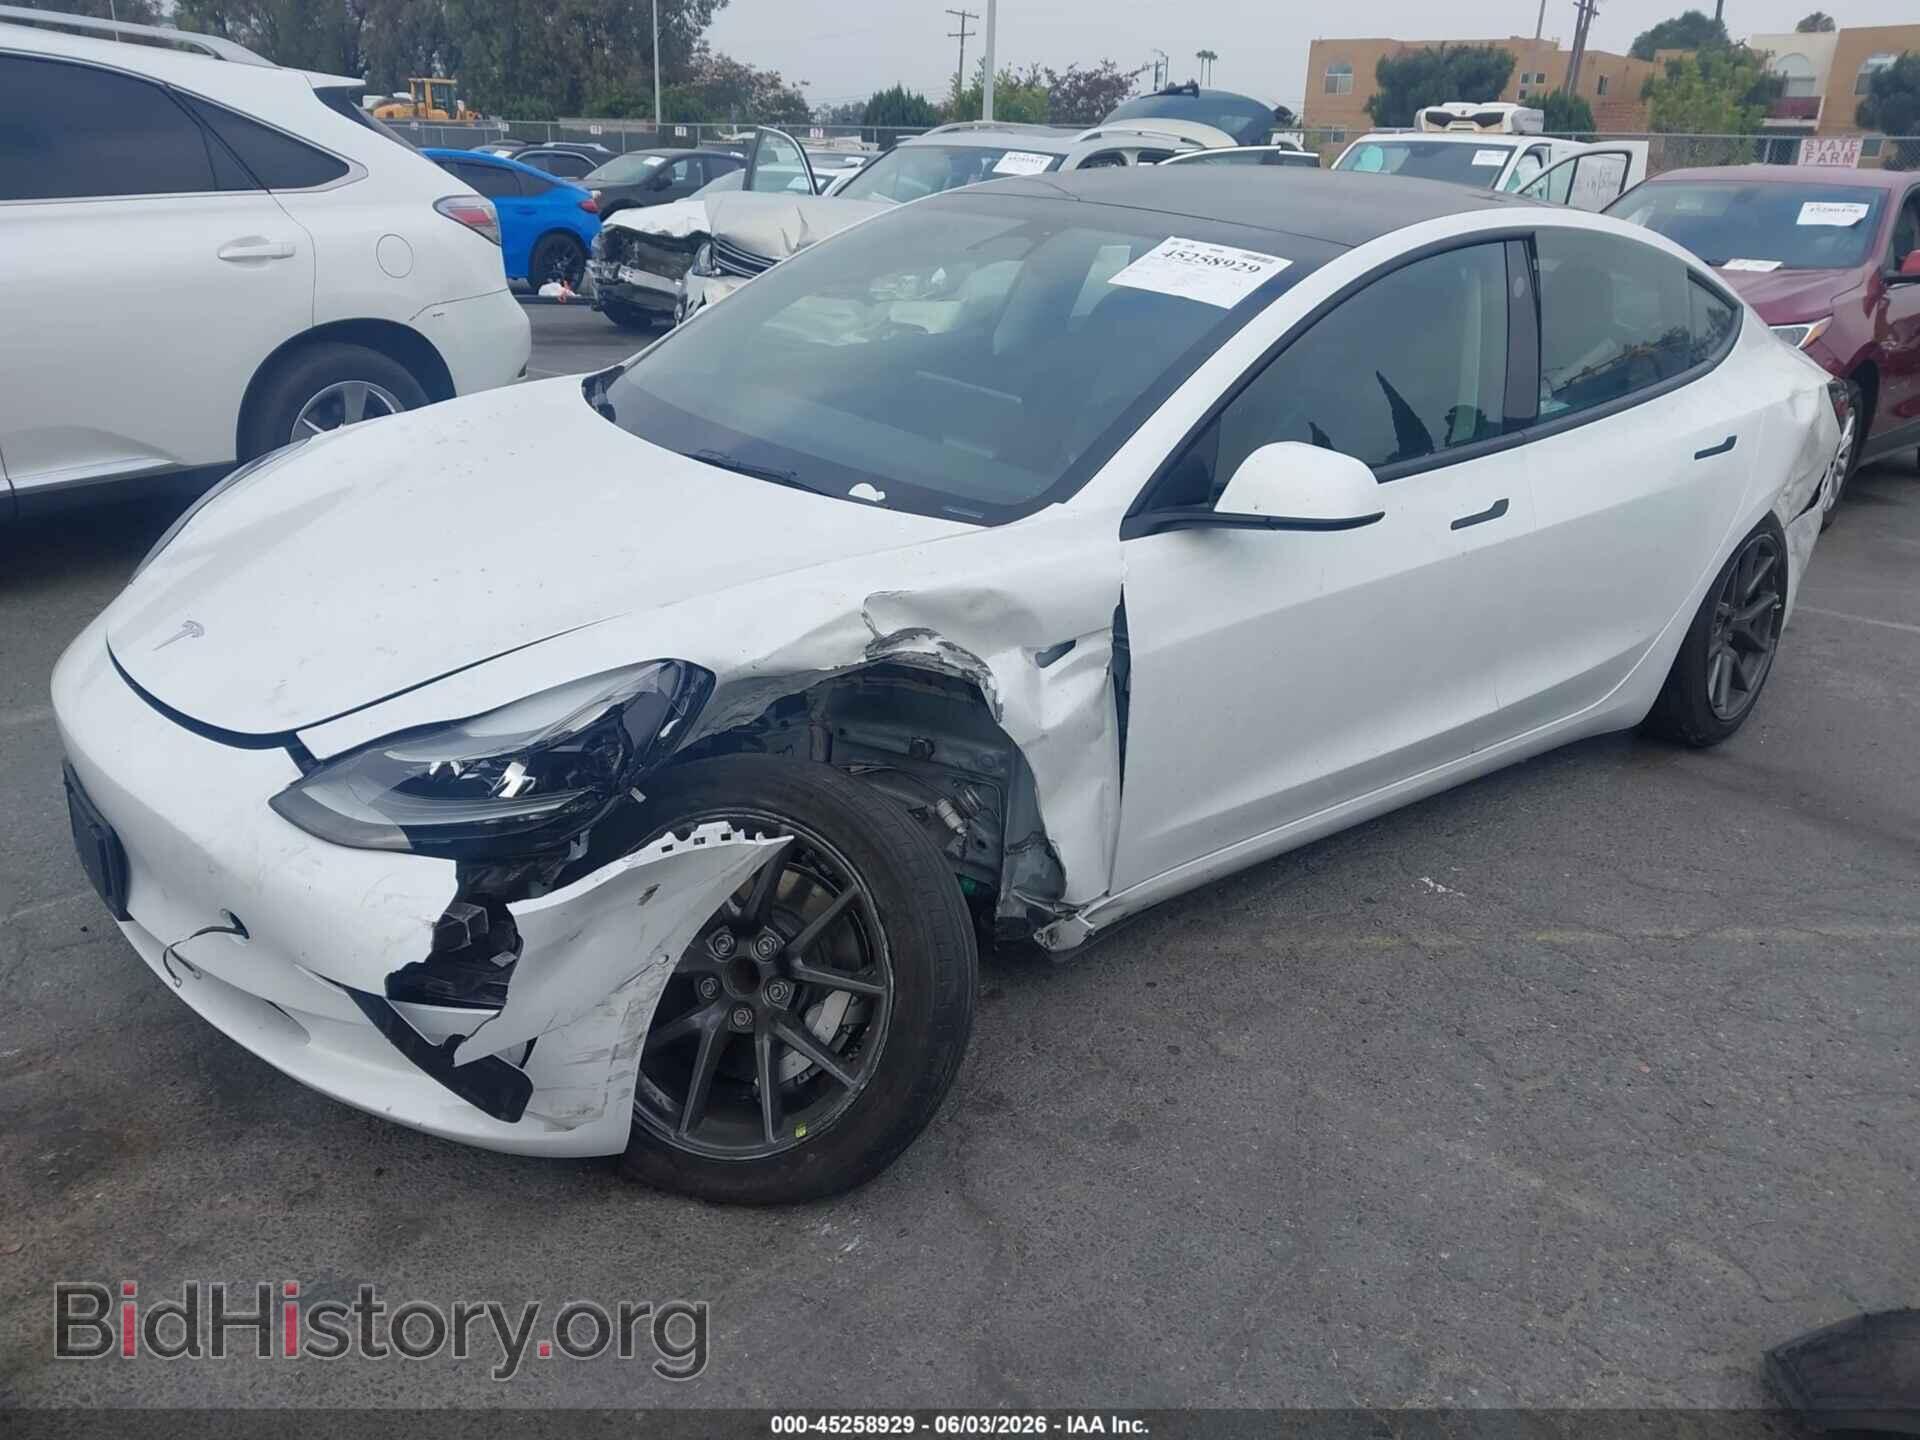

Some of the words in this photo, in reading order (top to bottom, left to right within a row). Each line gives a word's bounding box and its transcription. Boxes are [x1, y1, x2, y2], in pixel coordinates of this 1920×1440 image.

[1805, 140, 1857, 152] STATE
[1804, 152, 1855, 163] FARM
[1162, 249, 1261, 273] 45258929
